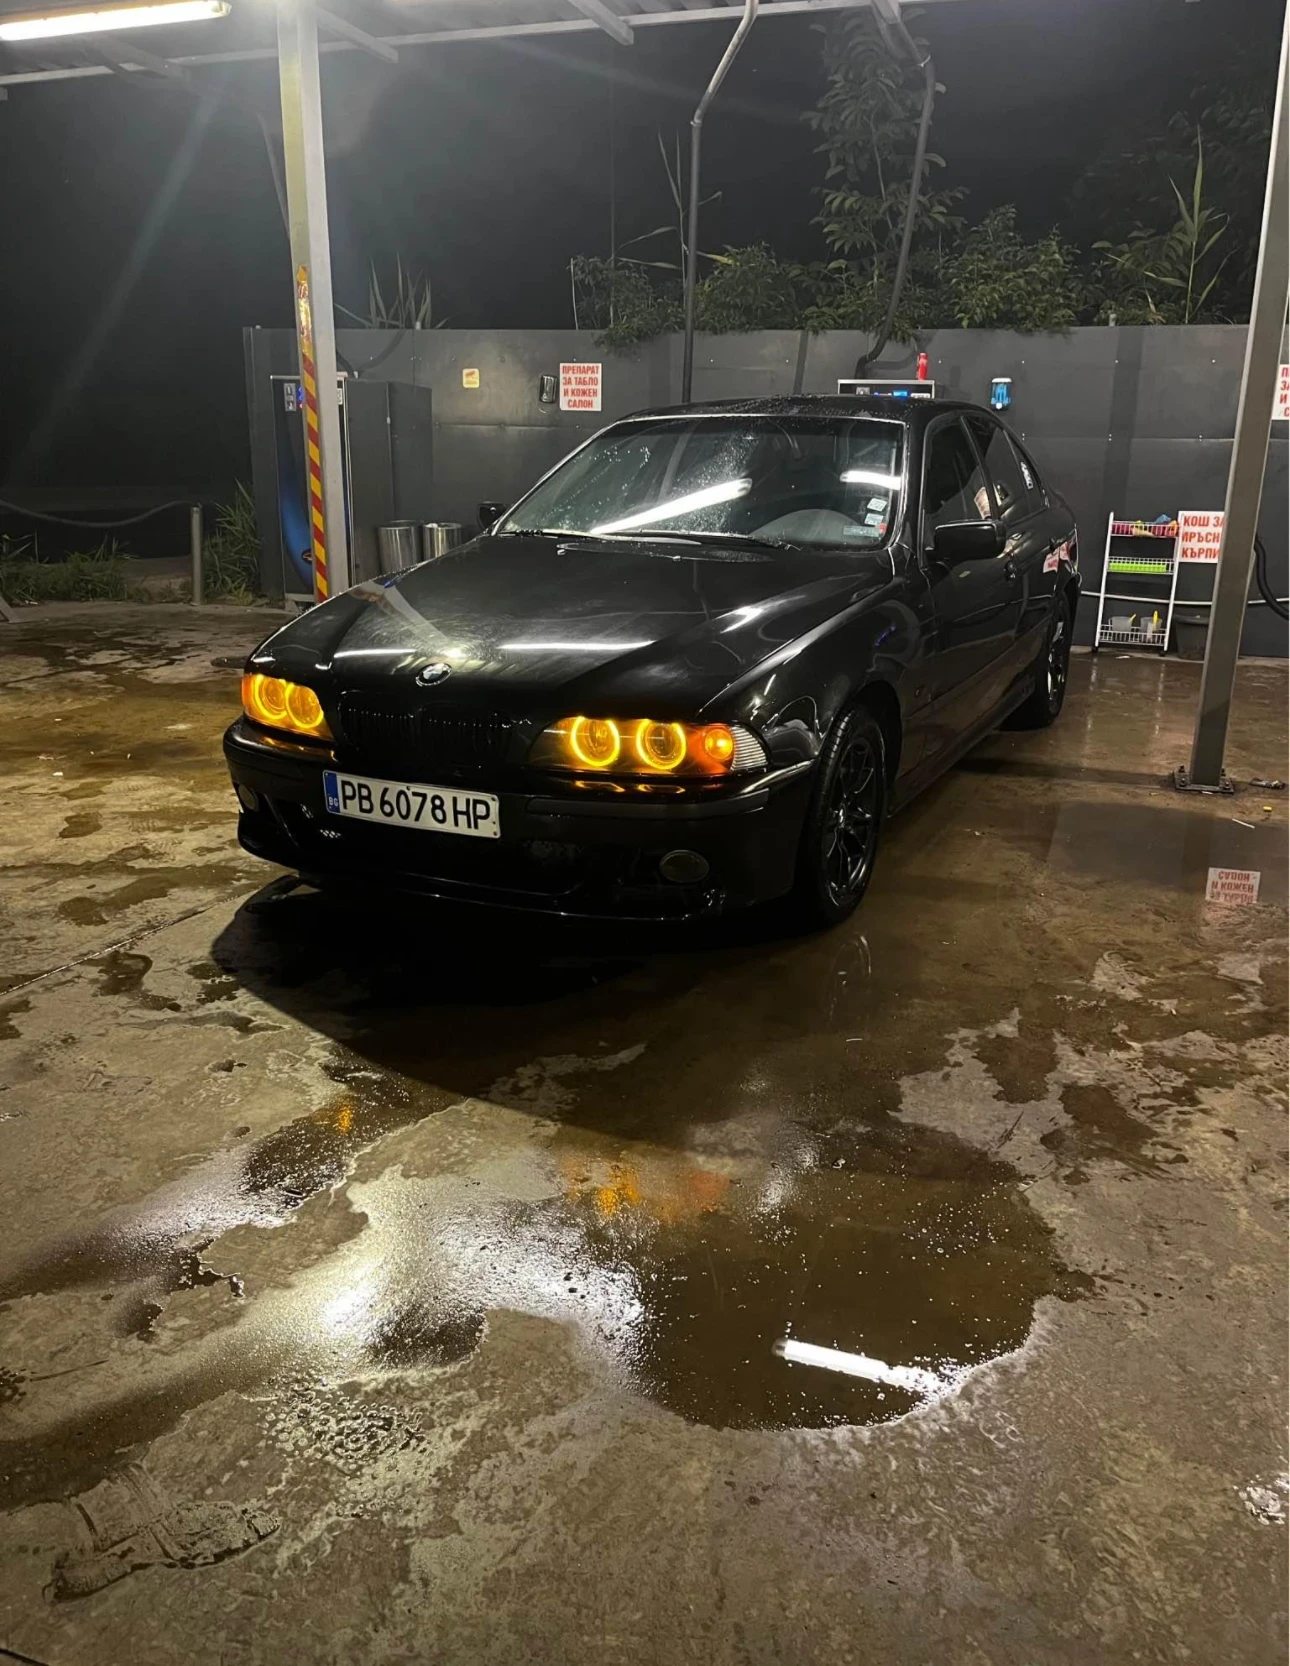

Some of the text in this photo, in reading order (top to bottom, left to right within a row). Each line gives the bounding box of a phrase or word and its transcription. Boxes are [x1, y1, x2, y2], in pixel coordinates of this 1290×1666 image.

[562, 365, 600, 375] ПРЕПАРАТ
[562, 377, 599, 386] ЗА ТАБЛО
[563, 388, 598, 397] И КОЖЕН
[567, 399, 594, 408] САЛОН
[1183, 515, 1211, 527] КОШ
[328, 796, 339, 807] BG
[340, 780, 491, 830] PB 6078 HP
